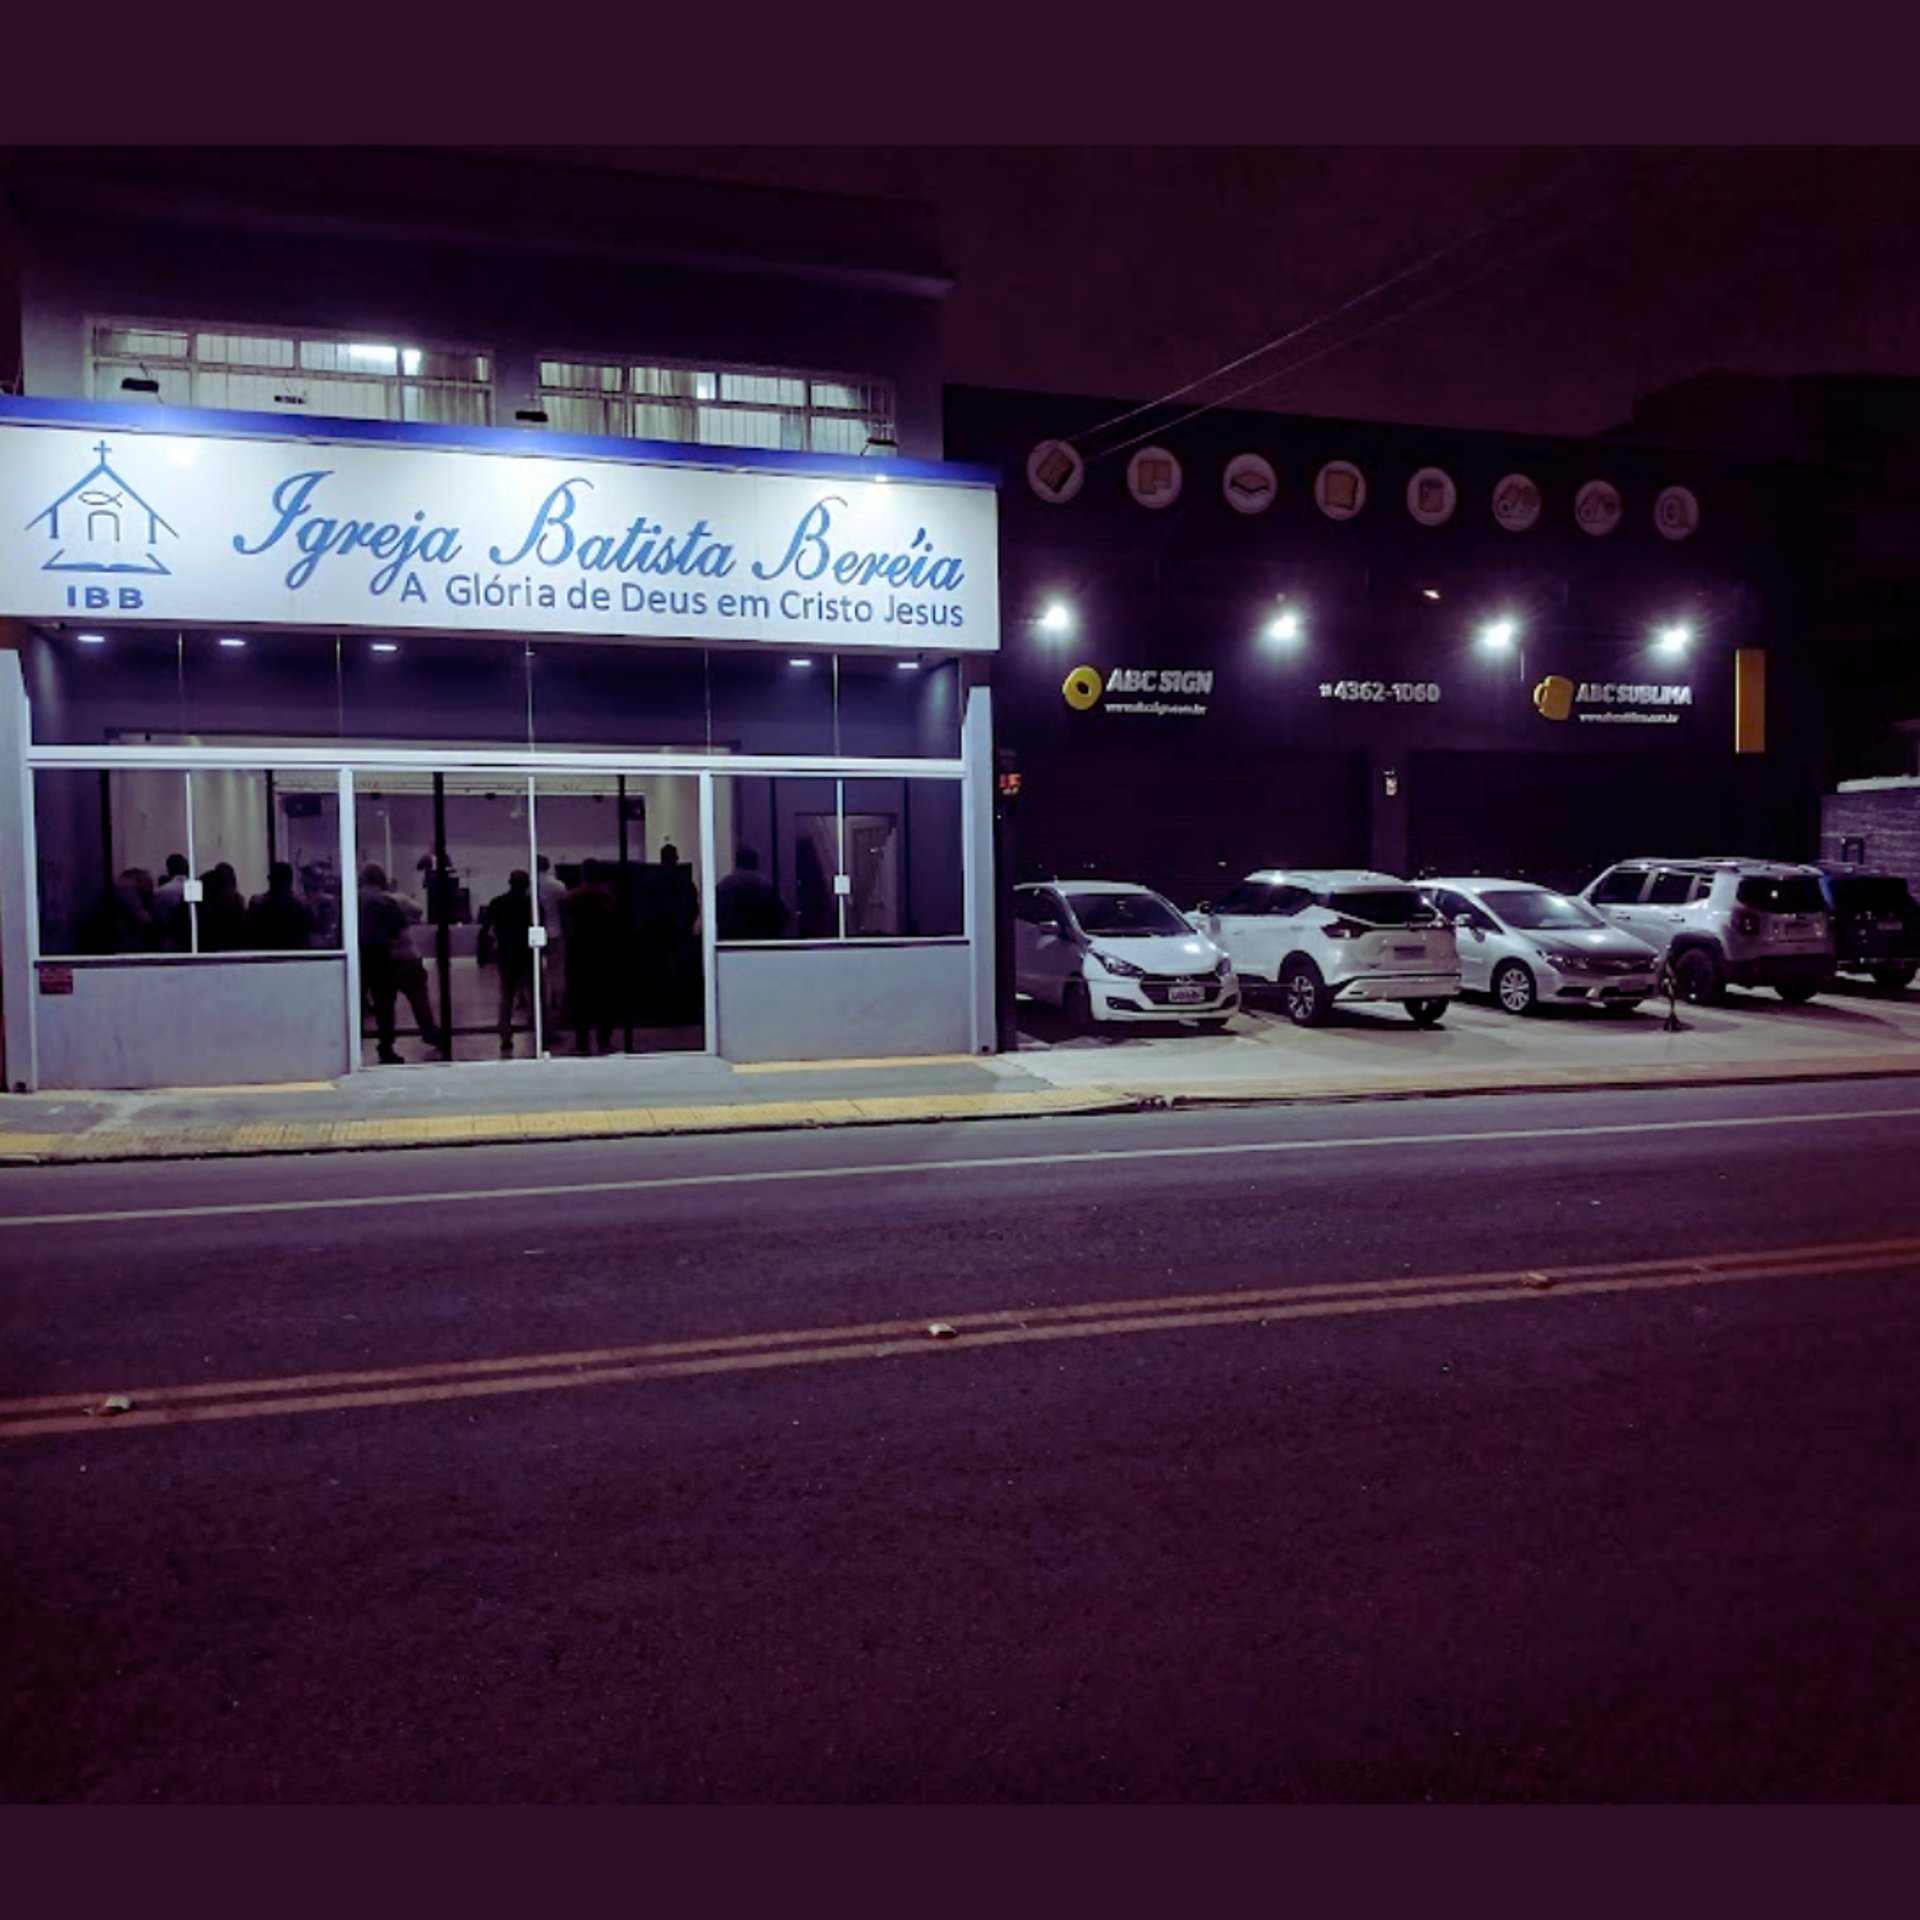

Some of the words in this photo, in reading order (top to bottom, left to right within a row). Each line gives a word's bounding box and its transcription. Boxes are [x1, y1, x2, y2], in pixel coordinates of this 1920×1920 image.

[233, 470, 463, 596] Igreja
[489, 477, 737, 578] Batista
[752, 496, 965, 591] Beréia
[66, 585, 144, 609] IBB
[400, 572, 427, 603] A
[445, 574, 556, 608] Glória
[567, 578, 610, 611] de
[621, 582, 707, 616] Deus
[717, 594, 770, 619] em
[779, 590, 873, 622] Cristo
[883, 595, 964, 627] Jesus
[1106, 668, 1157, 692] ABC
[1159, 670, 1214, 694] SIGN
[1334, 680, 1441, 703] 4362-1060
